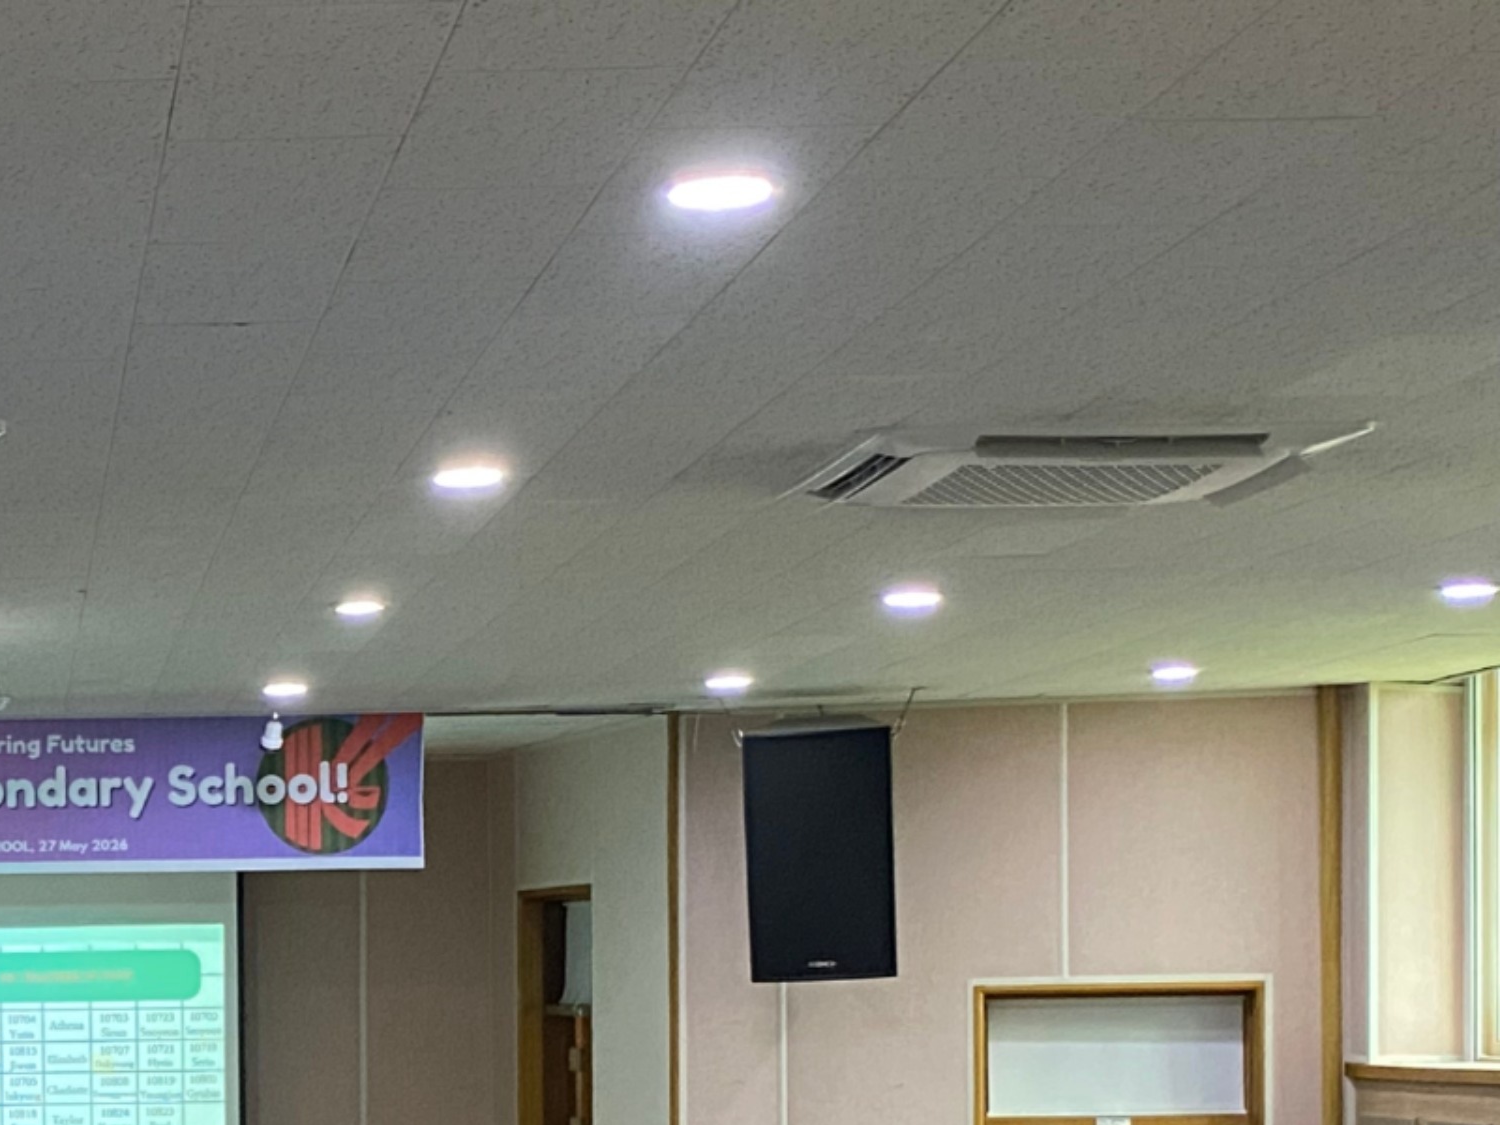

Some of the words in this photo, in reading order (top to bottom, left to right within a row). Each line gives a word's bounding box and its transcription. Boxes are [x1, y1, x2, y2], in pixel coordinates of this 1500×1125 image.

[46, 734, 136, 754] Futures
[168, 761, 350, 805] School!
[39, 840, 56, 852] 27
[58, 840, 88, 854] May
[91, 839, 128, 851] 2026
